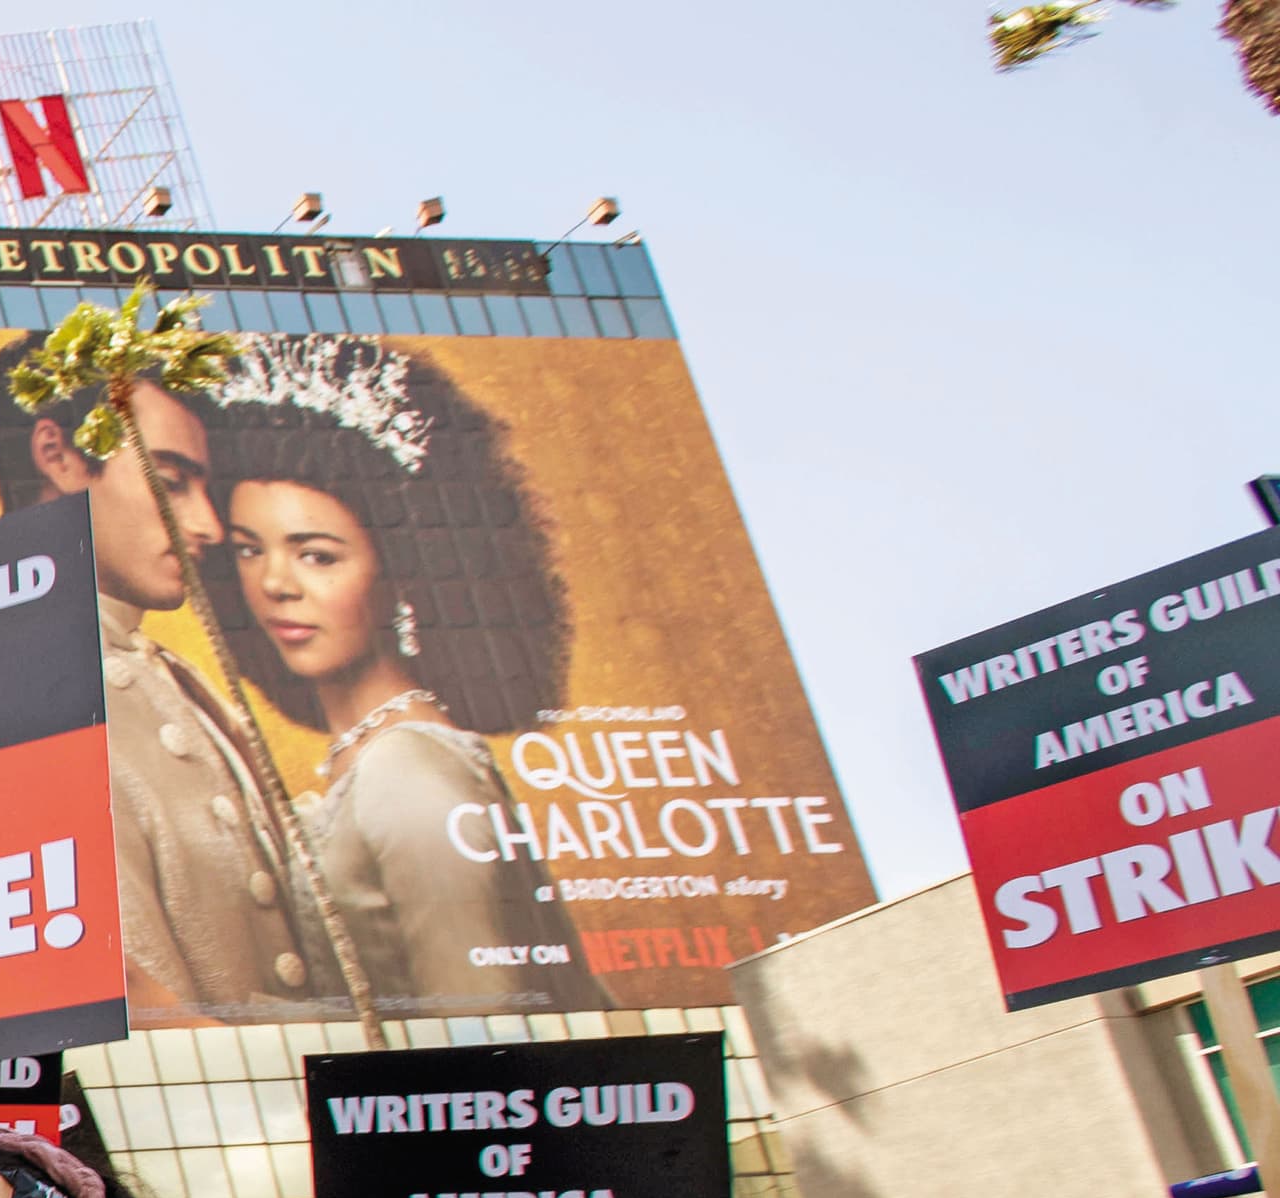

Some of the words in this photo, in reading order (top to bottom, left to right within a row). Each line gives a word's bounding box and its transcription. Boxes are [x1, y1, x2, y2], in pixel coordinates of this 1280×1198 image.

[938, 608, 1146, 706] WRITERS
[1095, 656, 1149, 697] OF
[1034, 671, 1256, 770] AMERICA
[510, 728, 741, 800] QUEEN
[1118, 766, 1213, 827] ON
[445, 796, 845, 864] CHARLOTTE
[534, 884, 556, 903] a
[558, 874, 721, 902] BRIDGERTON
[724, 875, 789, 901] story
[994, 805, 1280, 950] STRIK
[468, 946, 530, 967] ONLY
[531, 944, 572, 965] ON
[580, 925, 738, 977] NETFLIX
[328, 1088, 538, 1136] WRITERS
[544, 1081, 696, 1129] GUILD
[479, 1143, 532, 1178] OF
